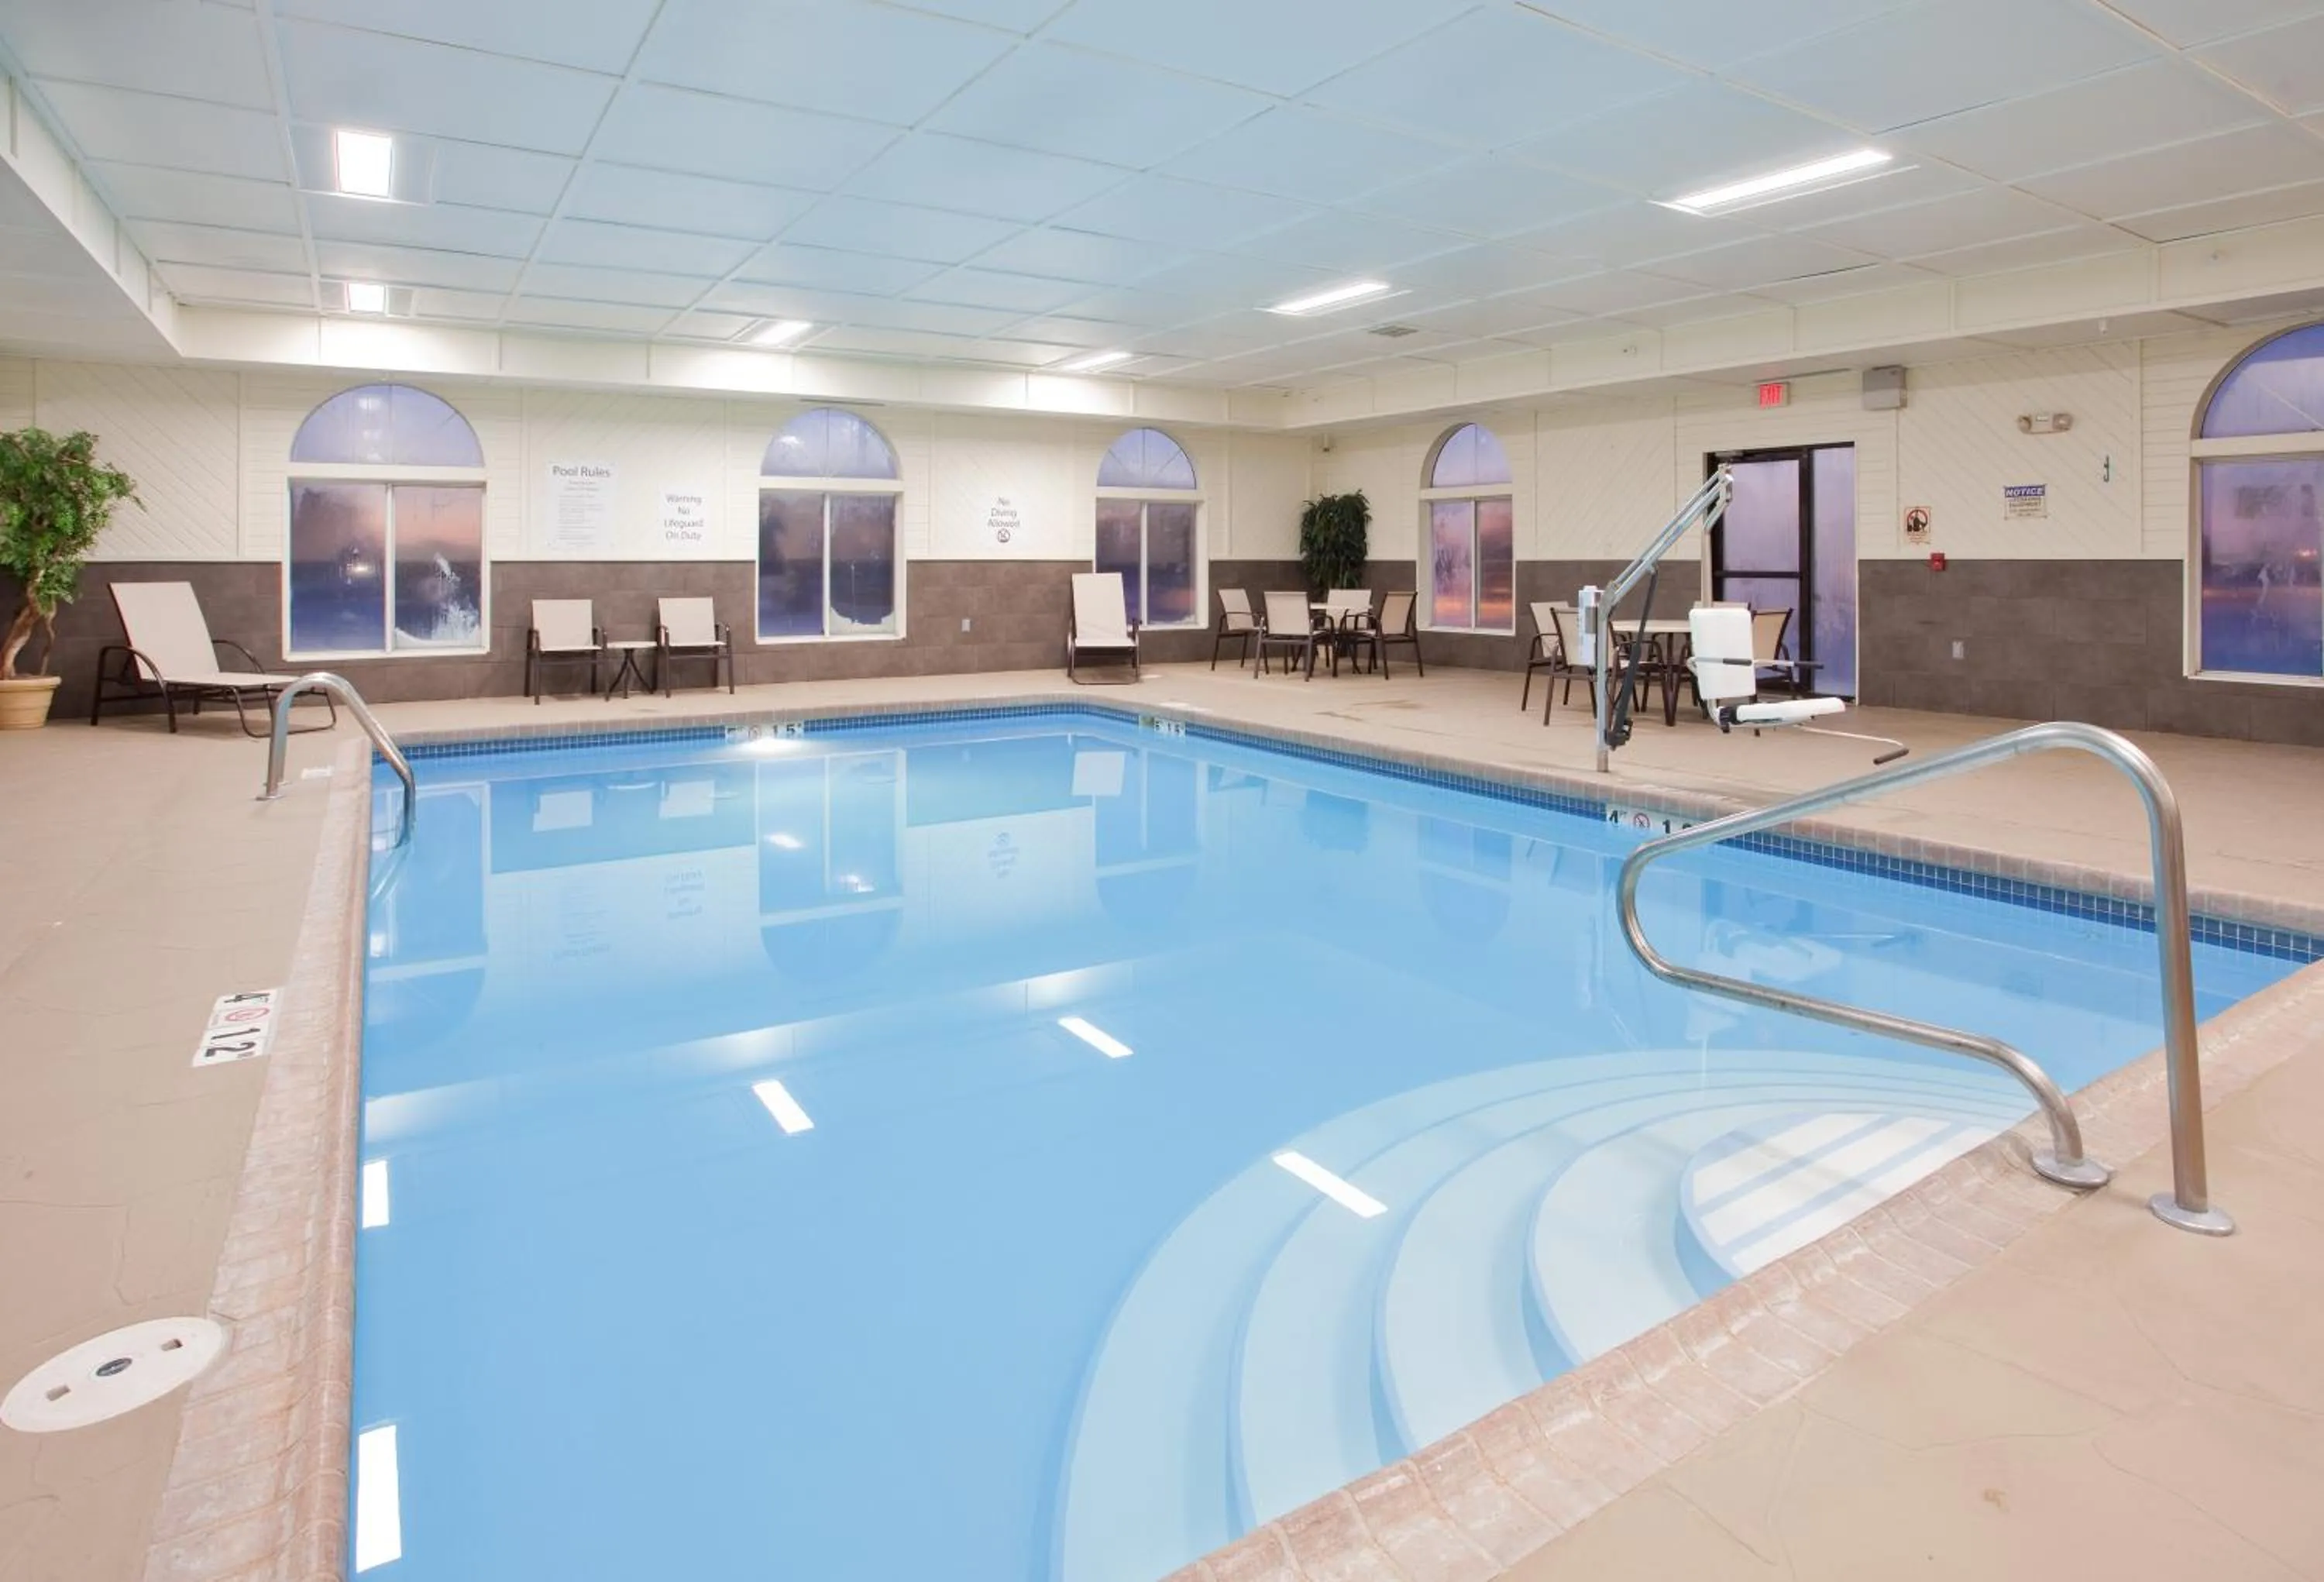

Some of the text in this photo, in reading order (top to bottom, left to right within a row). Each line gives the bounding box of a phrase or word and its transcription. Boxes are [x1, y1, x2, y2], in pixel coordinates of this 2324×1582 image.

[1760, 384, 1782, 407] EXIT
[552, 466, 610, 478] Pool Rules
[2006, 487, 2043, 497] NOTICE
